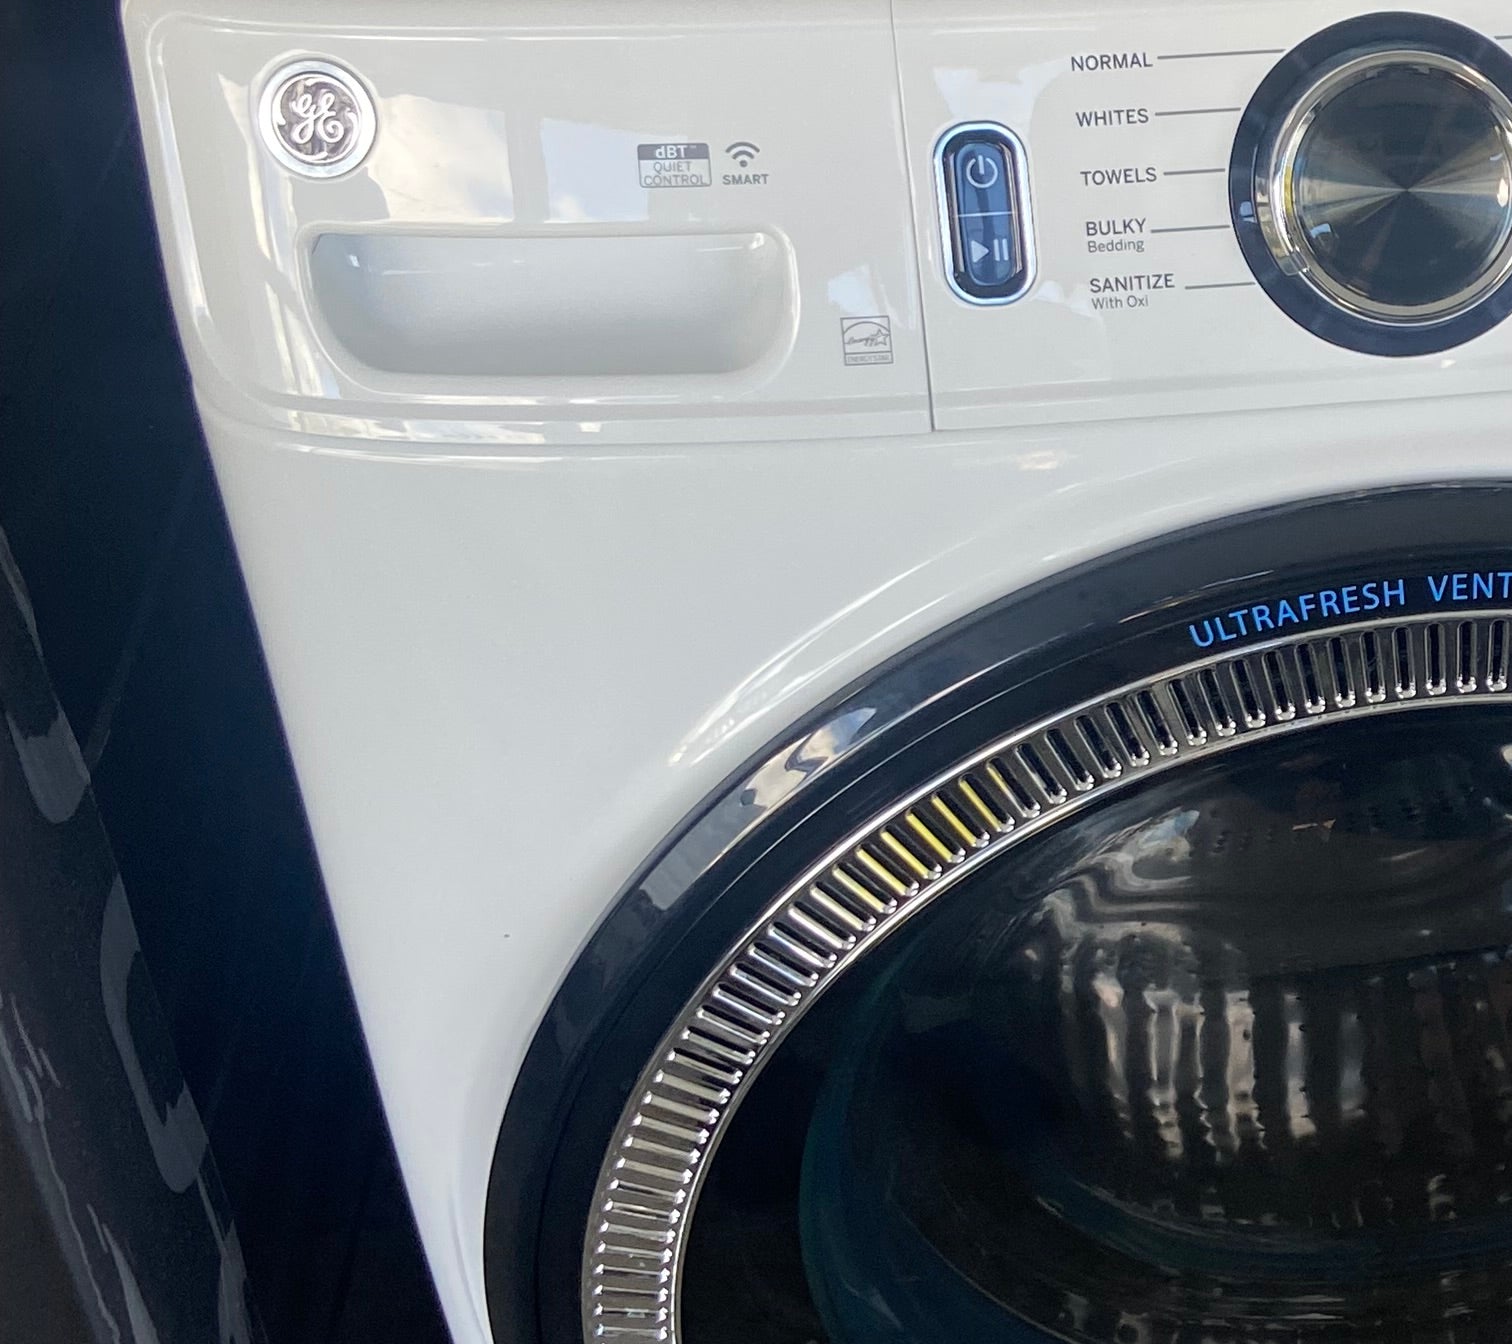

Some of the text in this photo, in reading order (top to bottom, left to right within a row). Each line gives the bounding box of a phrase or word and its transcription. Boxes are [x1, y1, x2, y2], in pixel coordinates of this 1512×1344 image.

[1071, 52, 1154, 72] NORMAL
[1076, 108, 1150, 128] WHITES
[653, 161, 692, 174] QUIET
[1080, 167, 1158, 186] TOWELS
[643, 174, 708, 186] CONTROL
[722, 174, 769, 185] SMART
[1085, 217, 1147, 237] BULKY
[1087, 238, 1145, 253] Bedding
[1089, 273, 1175, 294] SANITIZE
[1091, 294, 1150, 310] With Oxi
[1187, 578, 1406, 648] ULTRAFRESH
